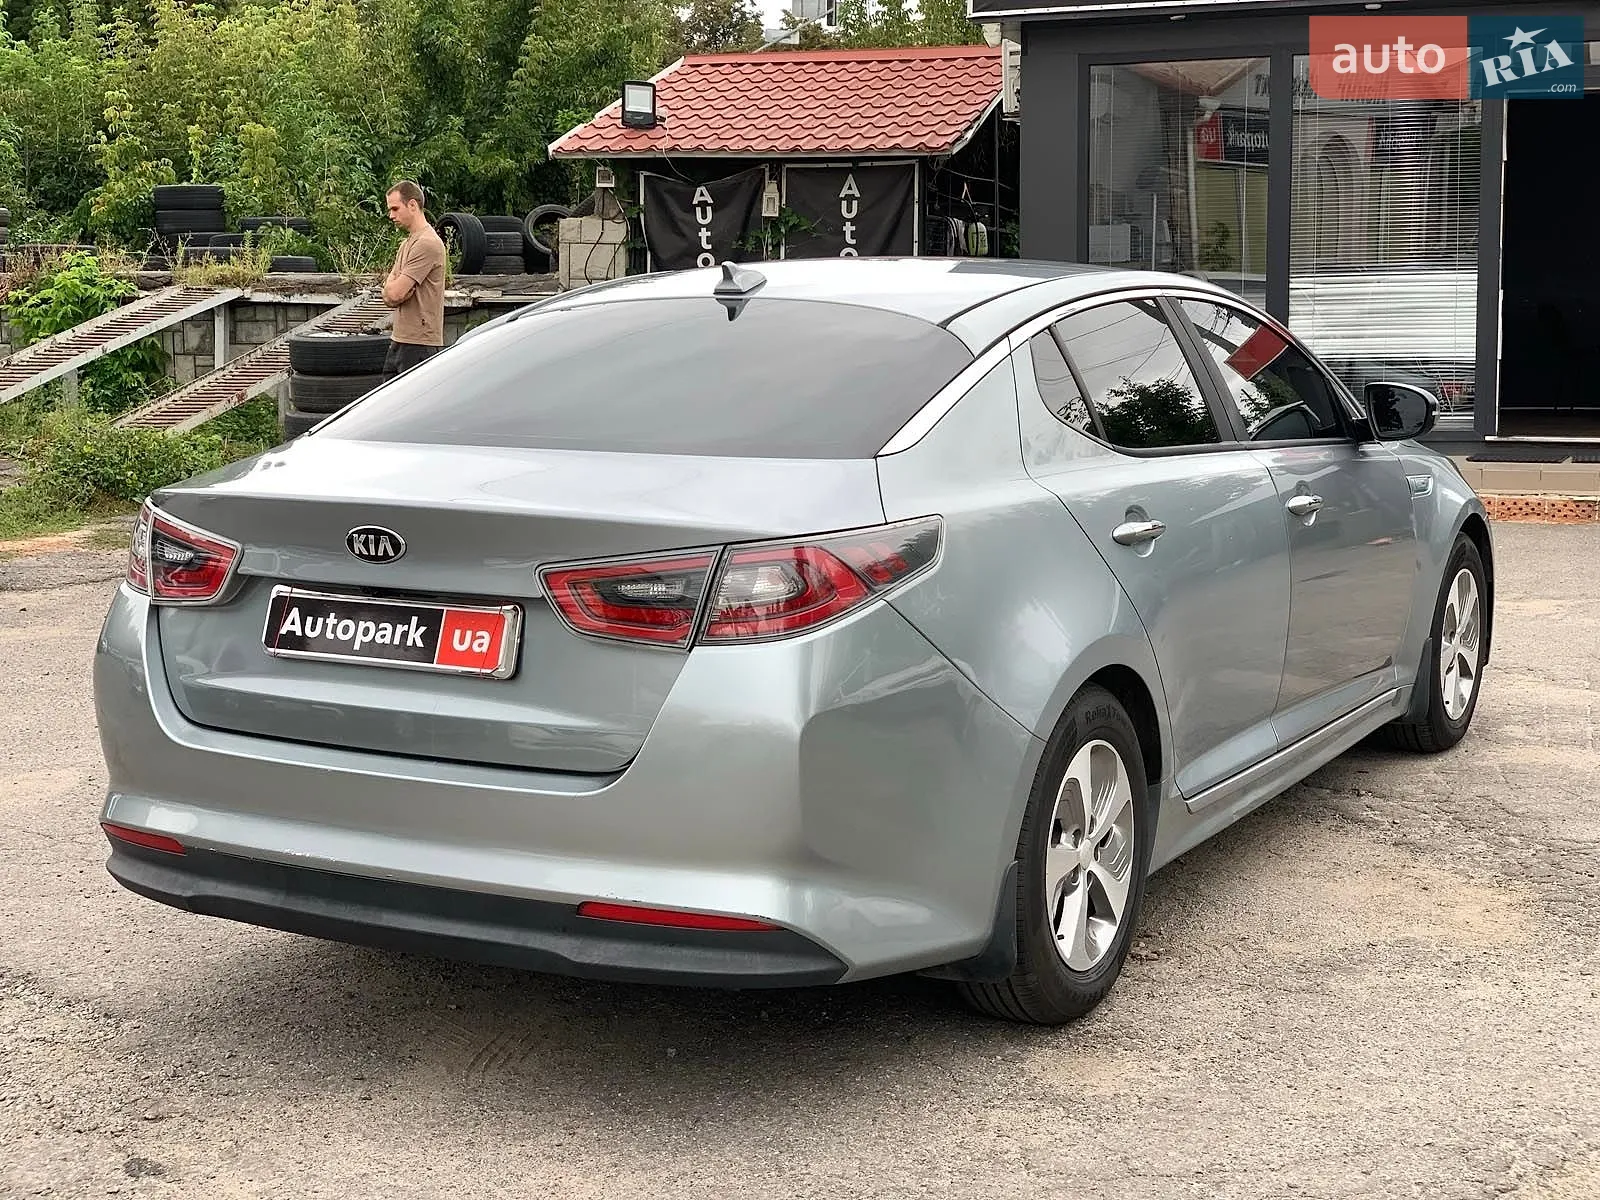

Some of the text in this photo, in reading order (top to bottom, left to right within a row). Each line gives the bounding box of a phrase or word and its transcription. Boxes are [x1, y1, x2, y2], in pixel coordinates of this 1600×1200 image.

[352, 533, 395, 557] KIA
[280, 606, 492, 653] Autopark ua
